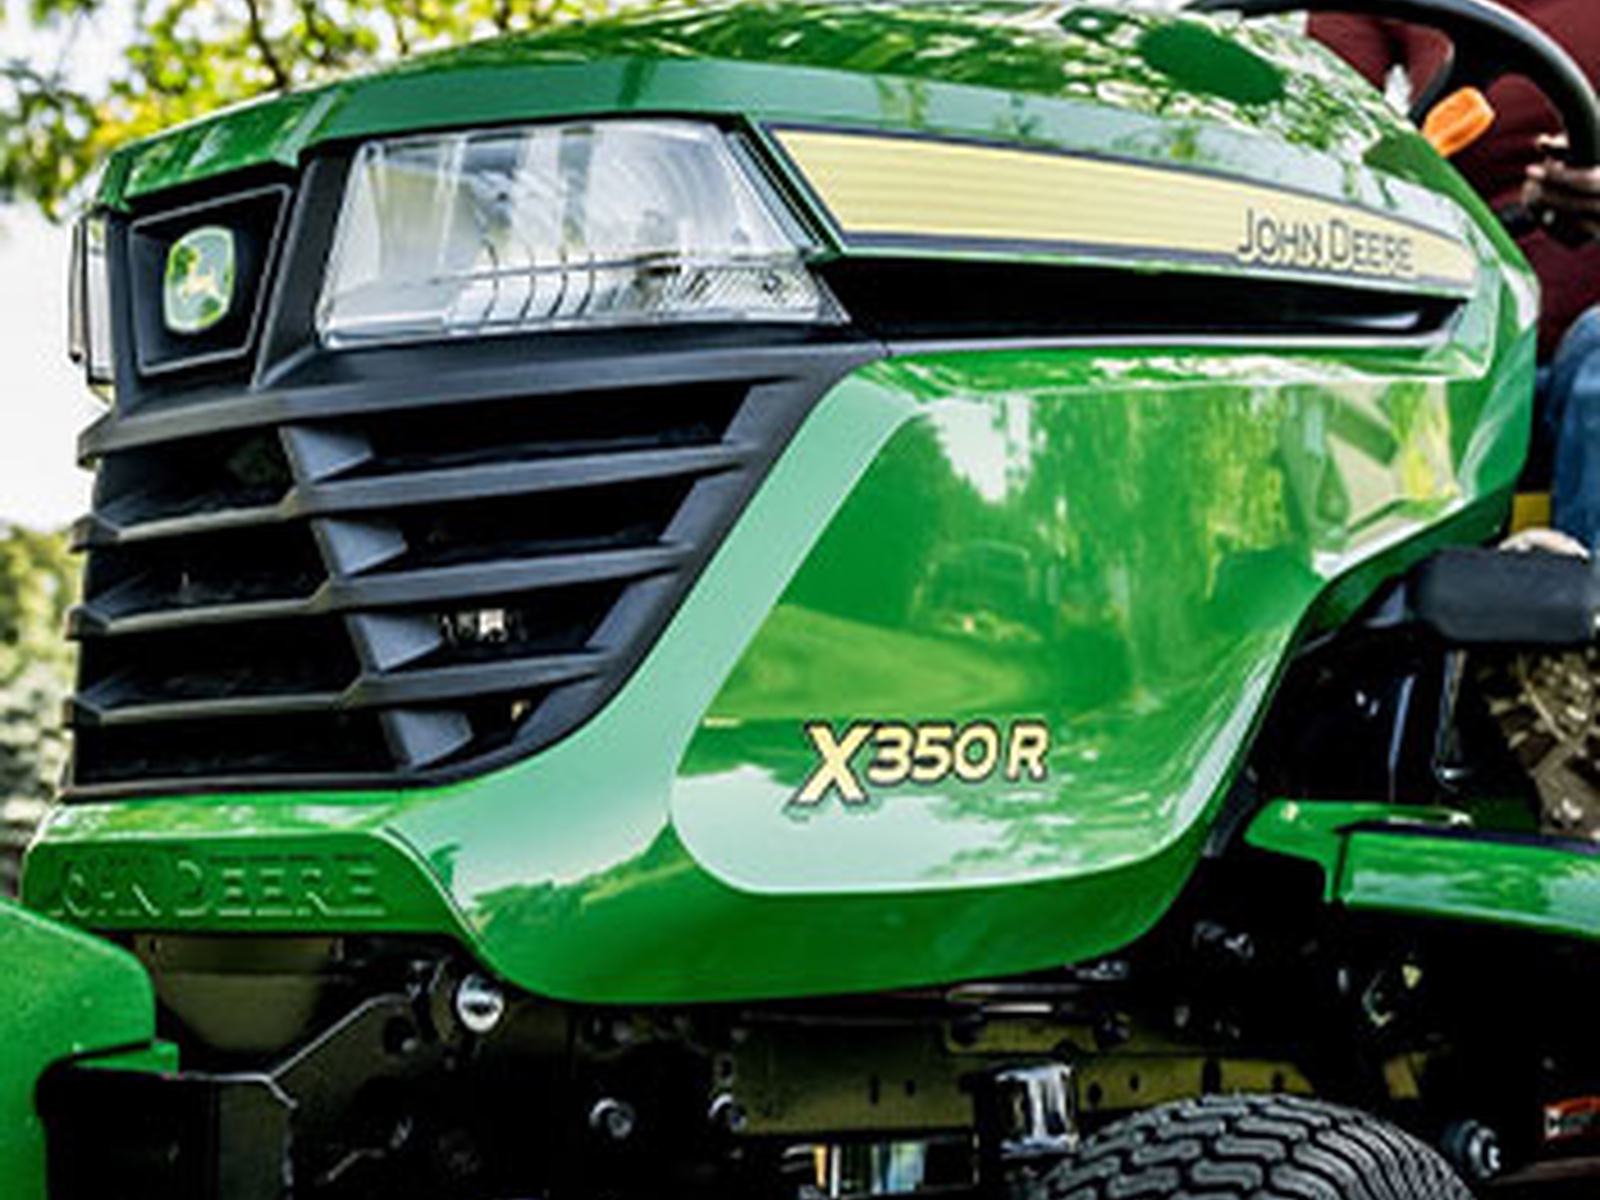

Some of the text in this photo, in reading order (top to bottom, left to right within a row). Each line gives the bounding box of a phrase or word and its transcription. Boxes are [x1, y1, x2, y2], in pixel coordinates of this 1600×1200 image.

[1237, 208, 1414, 272] JOHN DEERE
[173, 852, 386, 917] DEERE
